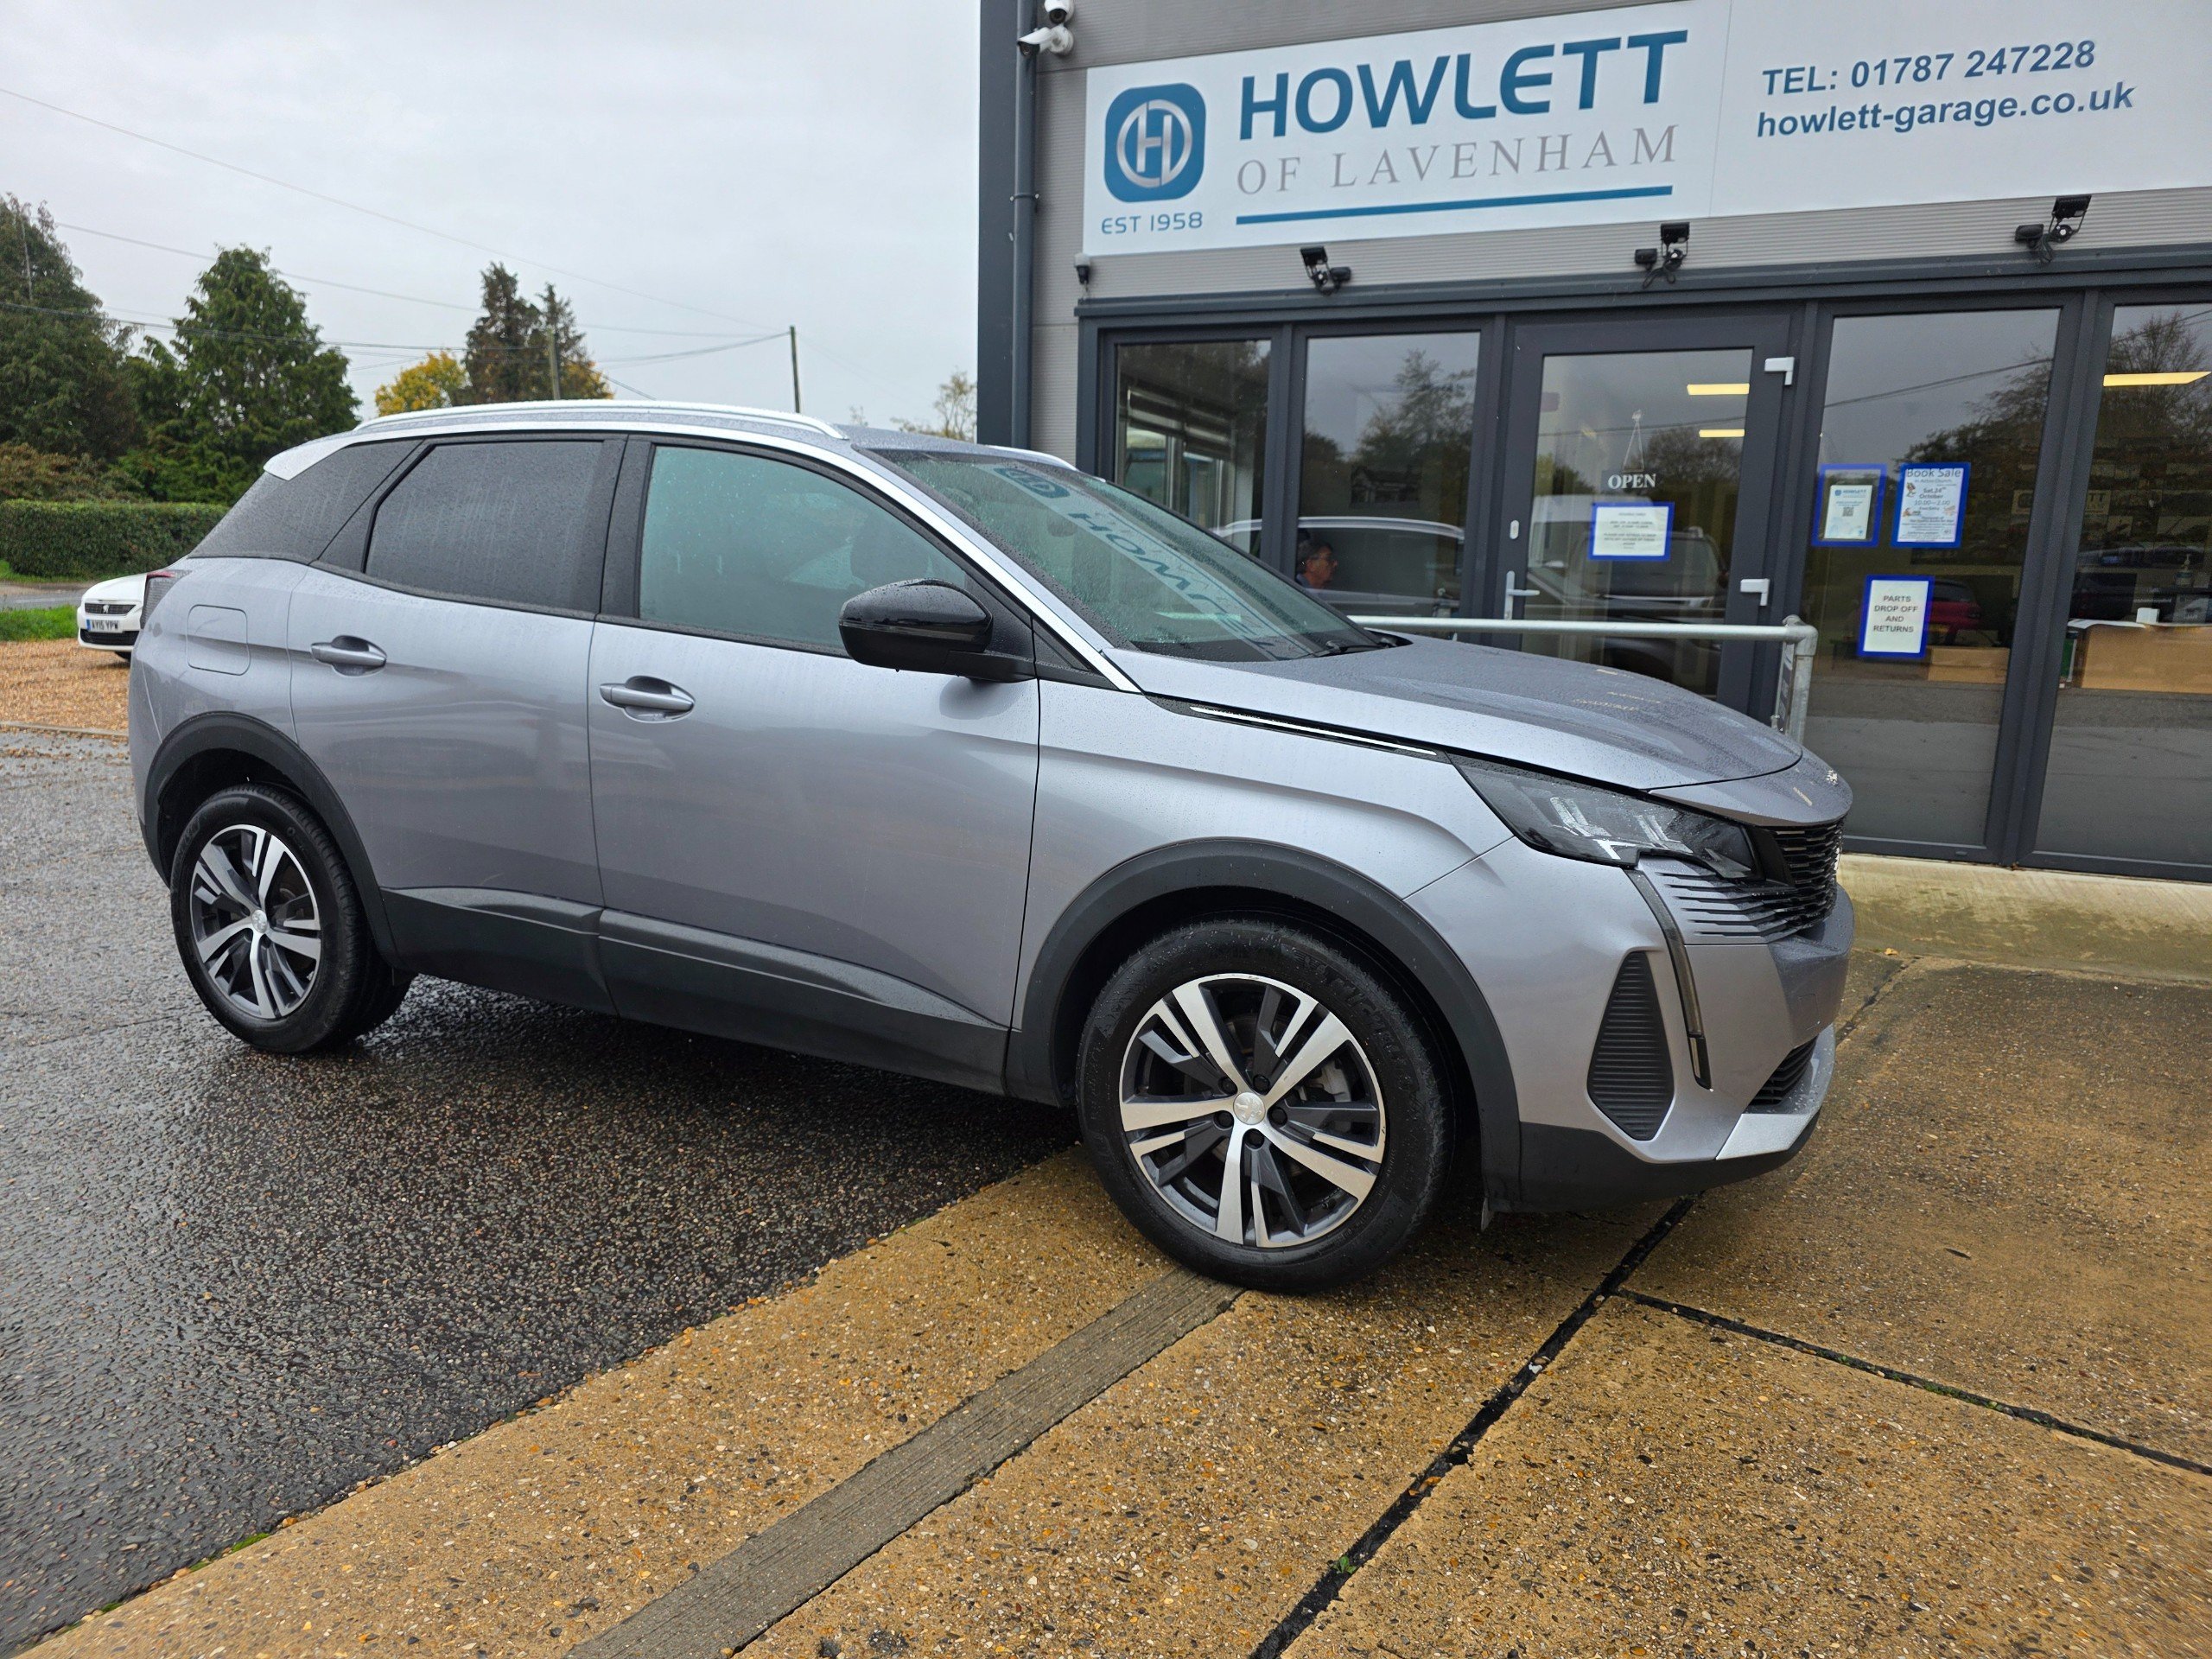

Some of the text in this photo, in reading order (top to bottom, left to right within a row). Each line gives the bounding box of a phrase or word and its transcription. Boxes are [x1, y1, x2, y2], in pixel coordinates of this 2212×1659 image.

[1239, 29, 1689, 141] HOWLETT
[1762, 40, 2095, 96] TEL: 01787 247228
[1757, 80, 2135, 138] howlett-garage.co.uk
[1236, 124, 1679, 195] OF LAVENHAM
[1101, 211, 1204, 235] EST 1958
[1608, 474, 1656, 489] OPEN
[1906, 468, 1962, 478] Book Sale
